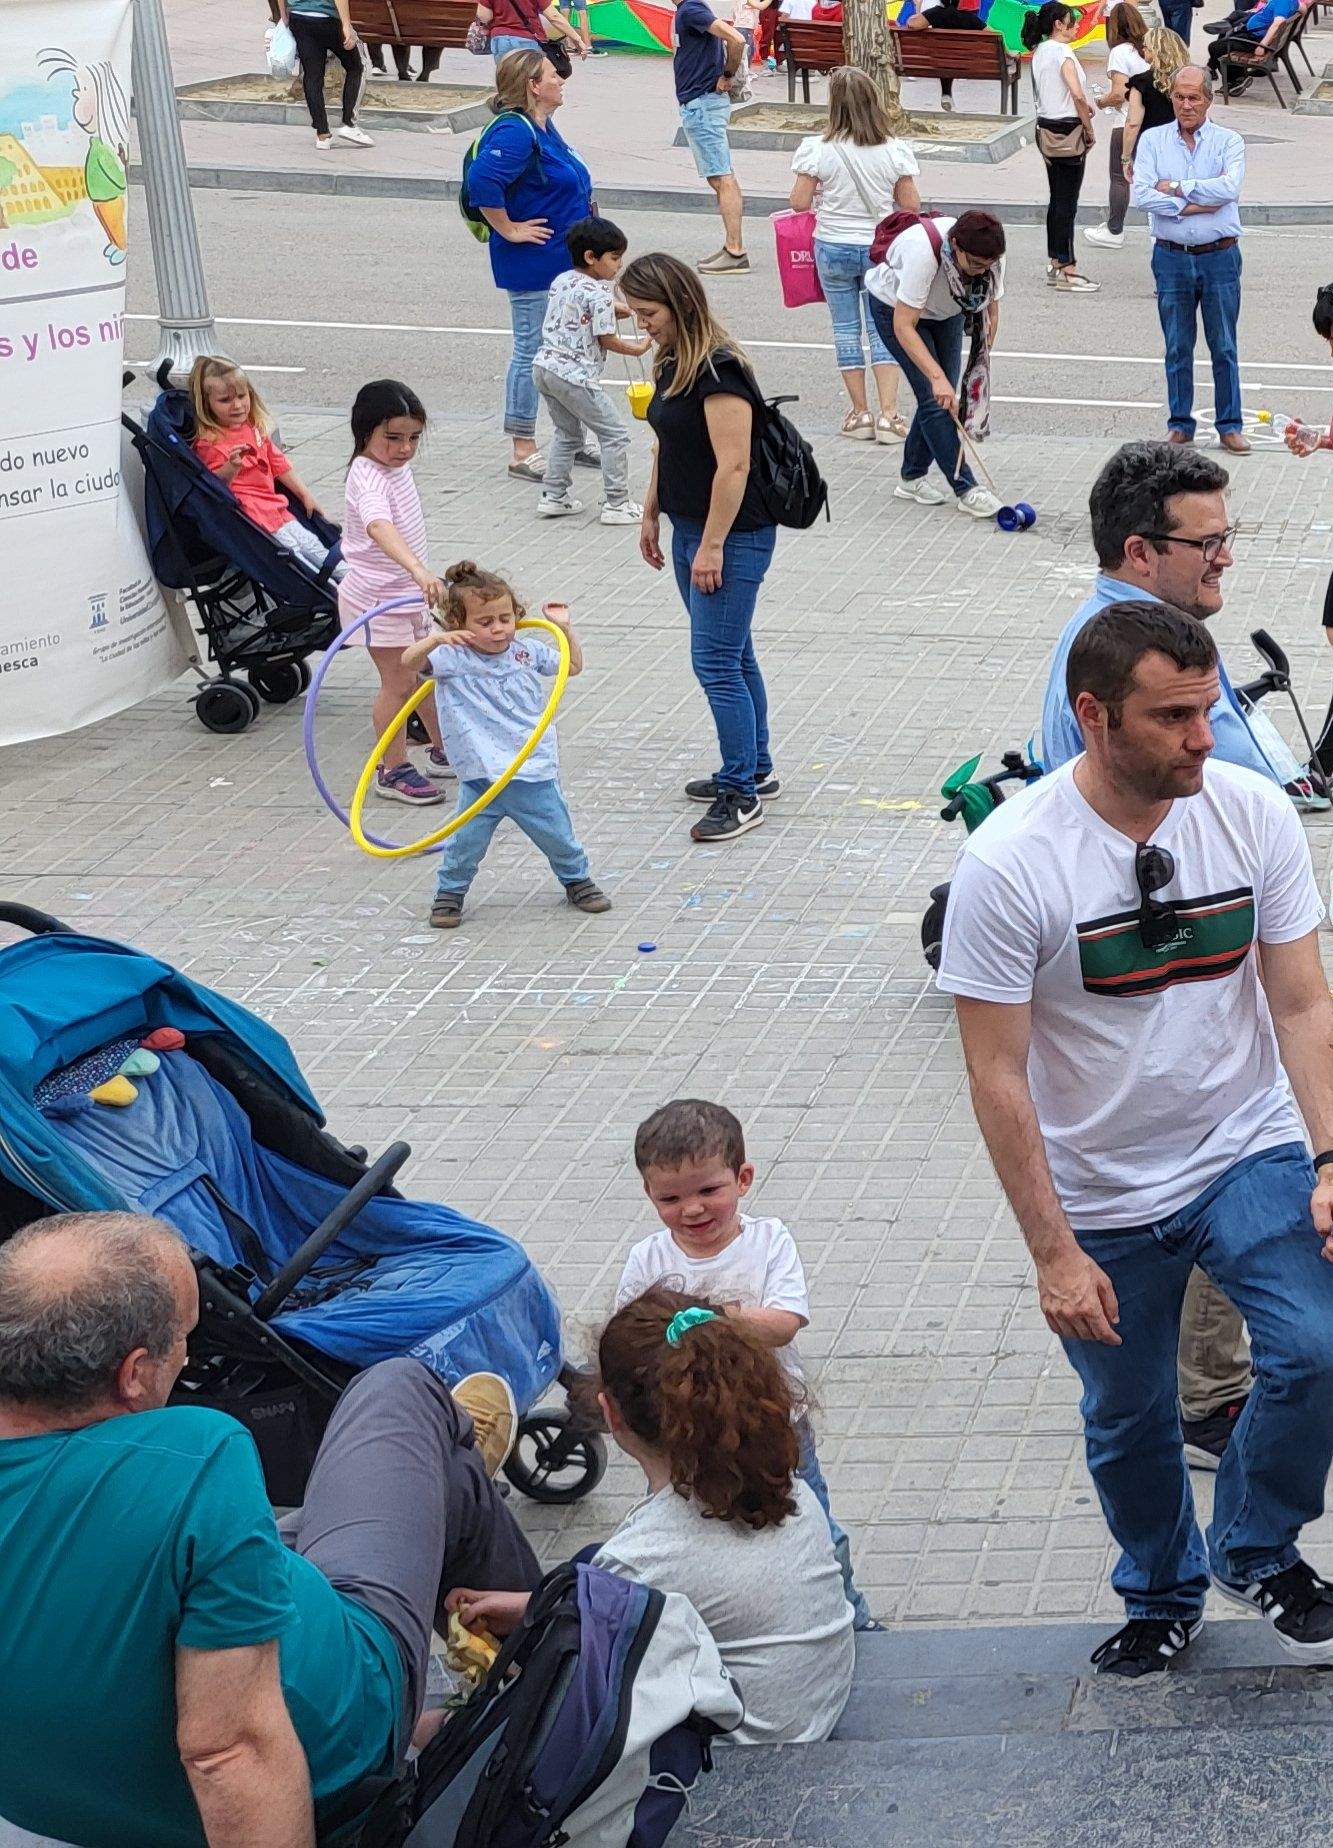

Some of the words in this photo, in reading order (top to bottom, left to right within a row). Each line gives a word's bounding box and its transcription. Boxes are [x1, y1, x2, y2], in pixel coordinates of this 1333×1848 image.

[1, 242, 39, 271] de
[22, 332, 39, 361] y
[48, 323, 91, 350] los
[32, 444, 89, 467] nuevo
[50, 478, 69, 499] la
